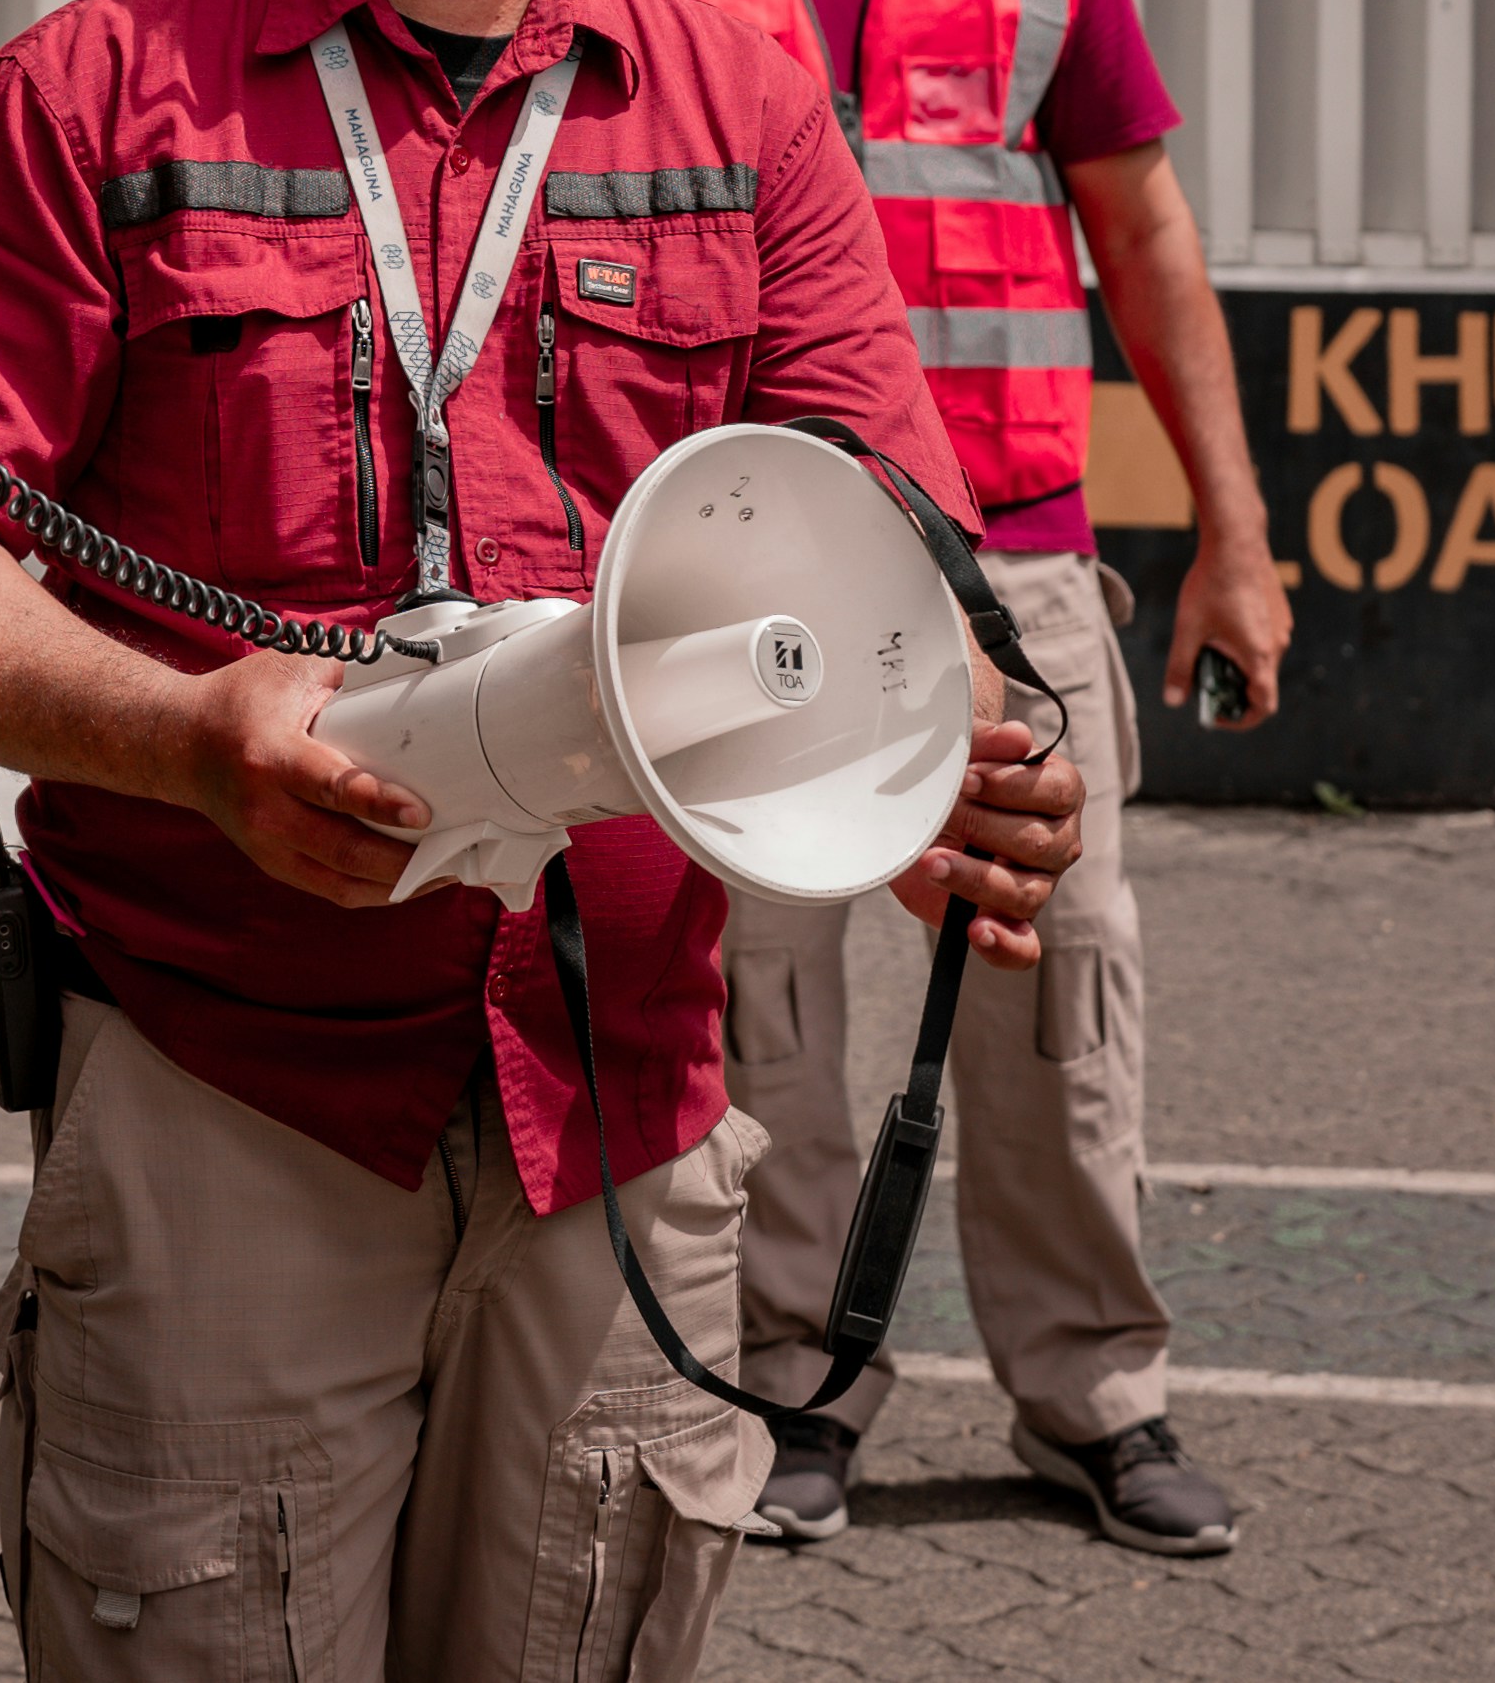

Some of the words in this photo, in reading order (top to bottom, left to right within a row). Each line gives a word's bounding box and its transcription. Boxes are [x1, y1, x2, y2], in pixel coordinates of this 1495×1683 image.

[345, 108, 383, 203] MAHAGUNA
[495, 152, 534, 238] MAHAGUNA
[587, 267, 630, 286] W-TAC
[776, 673, 805, 690] TOA
